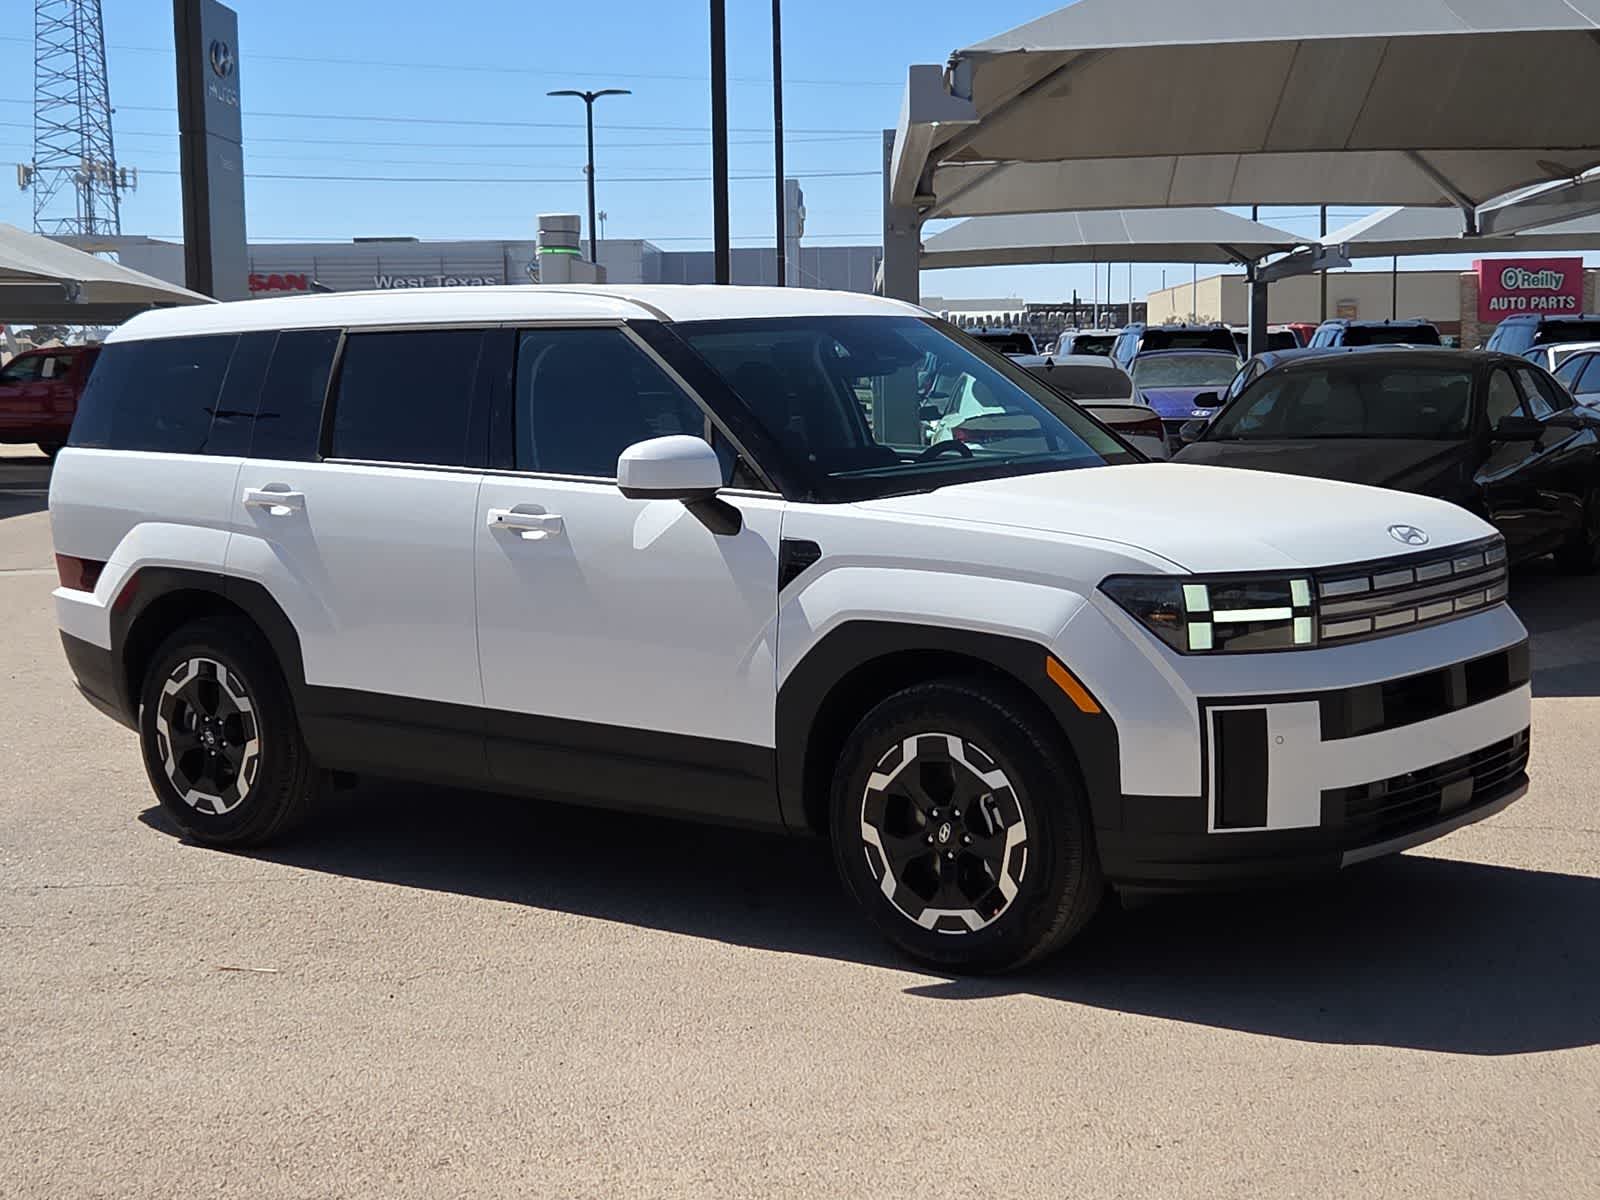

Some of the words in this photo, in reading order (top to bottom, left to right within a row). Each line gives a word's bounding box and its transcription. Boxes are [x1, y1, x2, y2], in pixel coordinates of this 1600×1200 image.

[374, 275, 424, 288] West
[432, 275, 496, 287] Texas
[1501, 267, 1564, 290] O'Reilly
[1489, 297, 1526, 310] AUTO
[1530, 296, 1576, 309] PARTS
